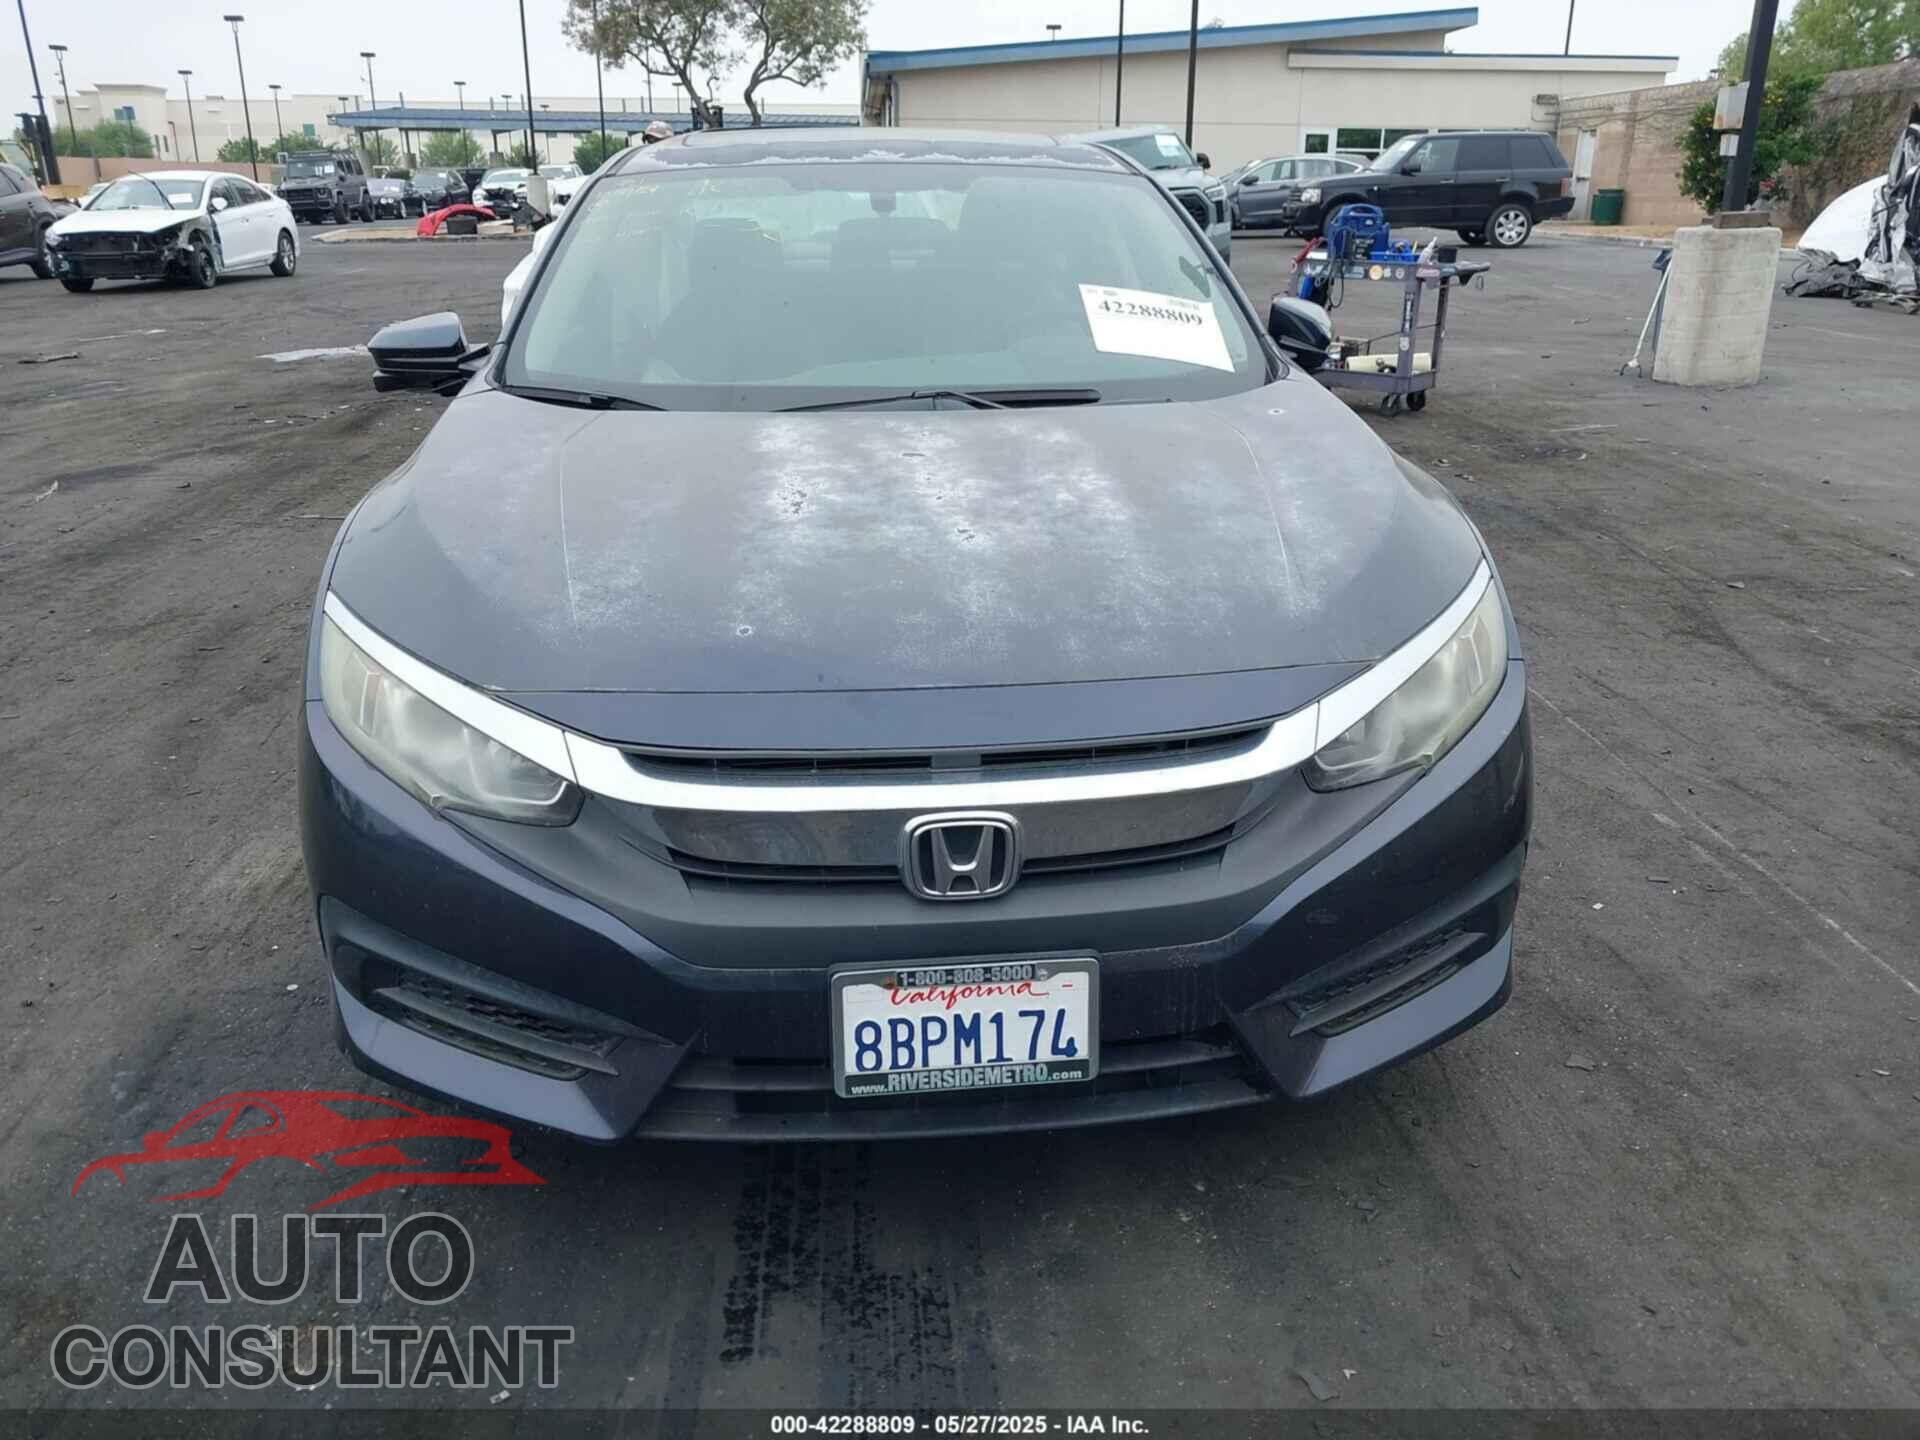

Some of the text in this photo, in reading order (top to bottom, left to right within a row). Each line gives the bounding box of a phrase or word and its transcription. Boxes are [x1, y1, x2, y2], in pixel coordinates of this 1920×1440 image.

[1099, 300, 1203, 326] 42288809
[899, 964, 1033, 987] 1-800-808-5000
[887, 979, 1049, 1010] California
[854, 1007, 1078, 1073] 8BPM174
[850, 1062, 1083, 1096] www.RIVERSIDEMETRO.com
